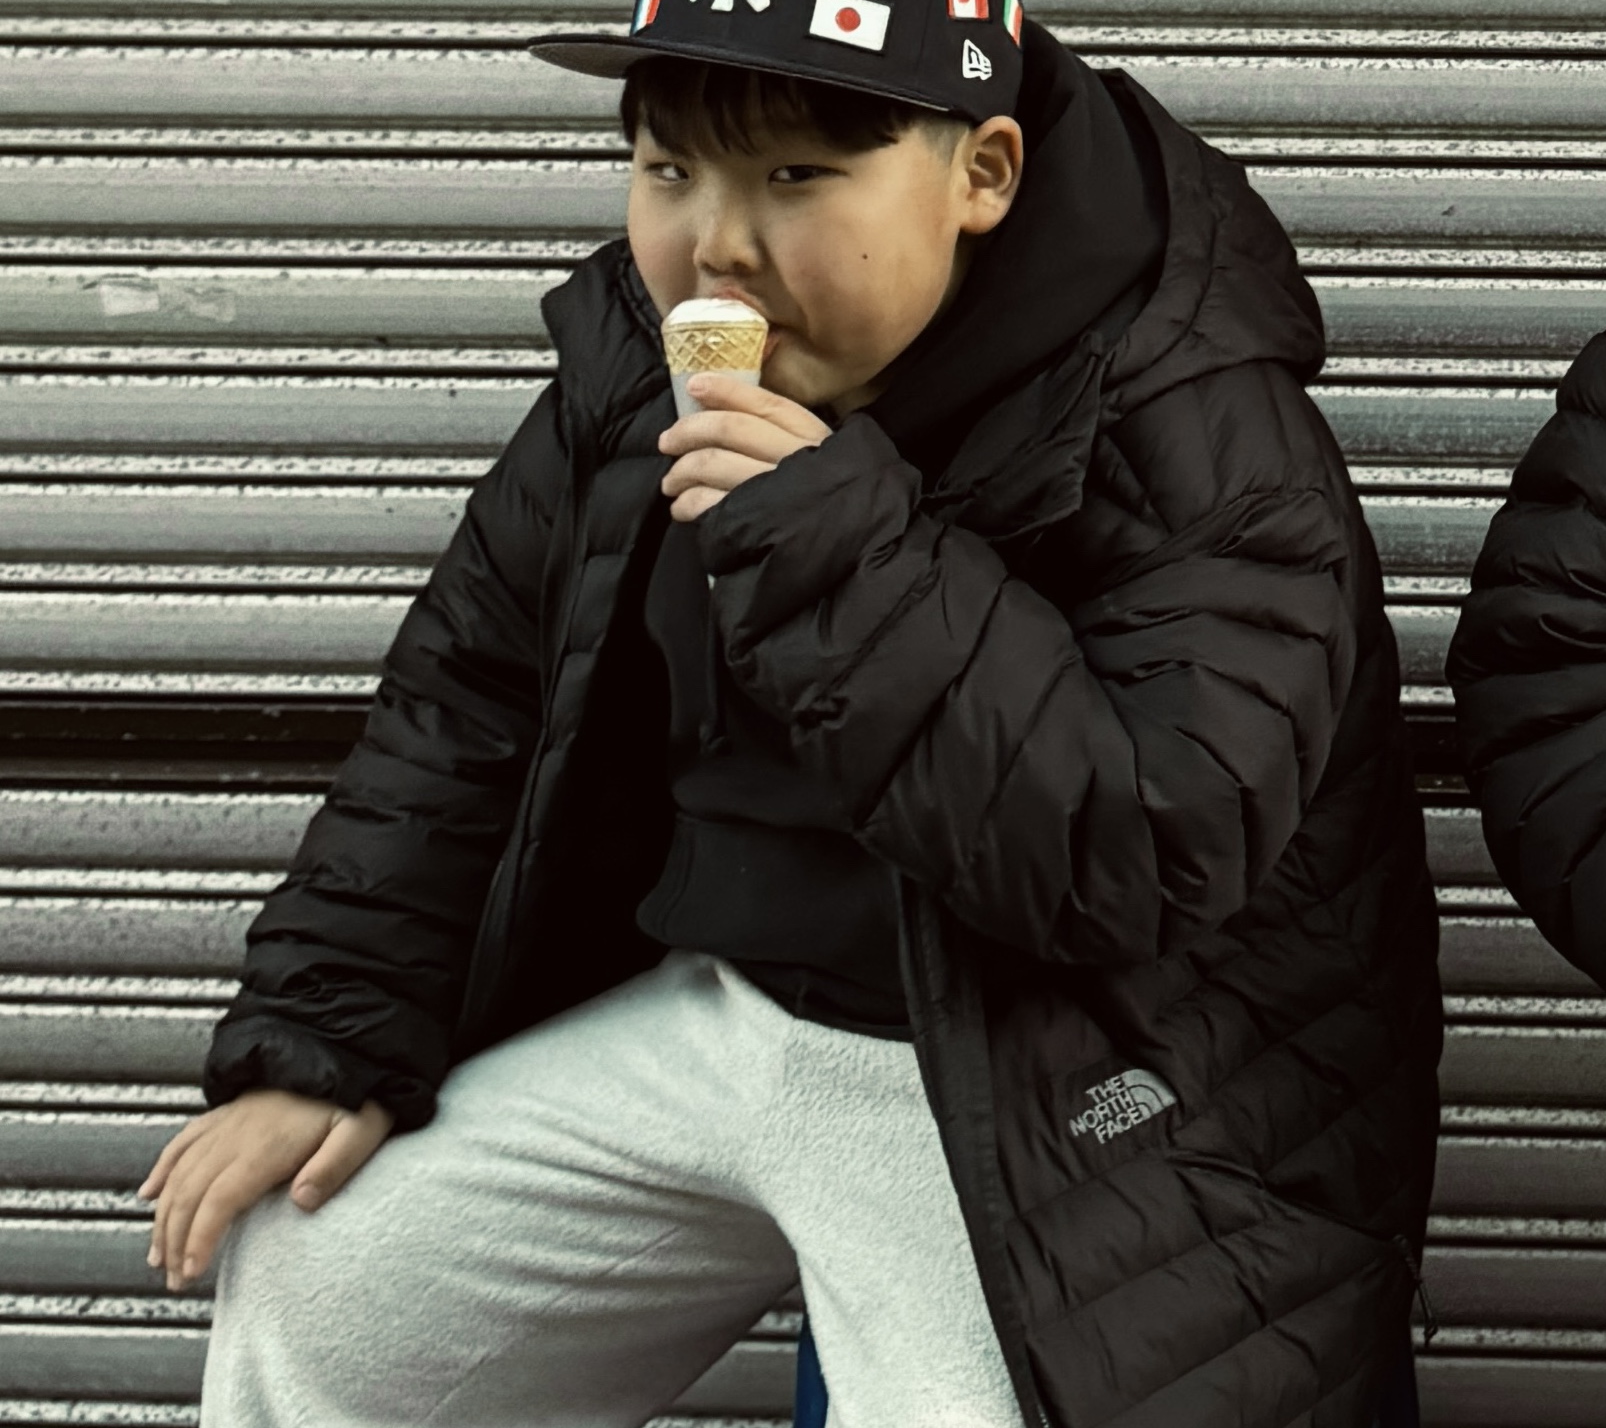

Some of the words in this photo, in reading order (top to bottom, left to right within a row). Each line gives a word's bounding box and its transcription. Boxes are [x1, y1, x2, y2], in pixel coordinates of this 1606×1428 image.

[1085, 1075, 1124, 1103] THE
[1069, 1087, 1136, 1137] NORTH
[1094, 1106, 1144, 1145] FACE
